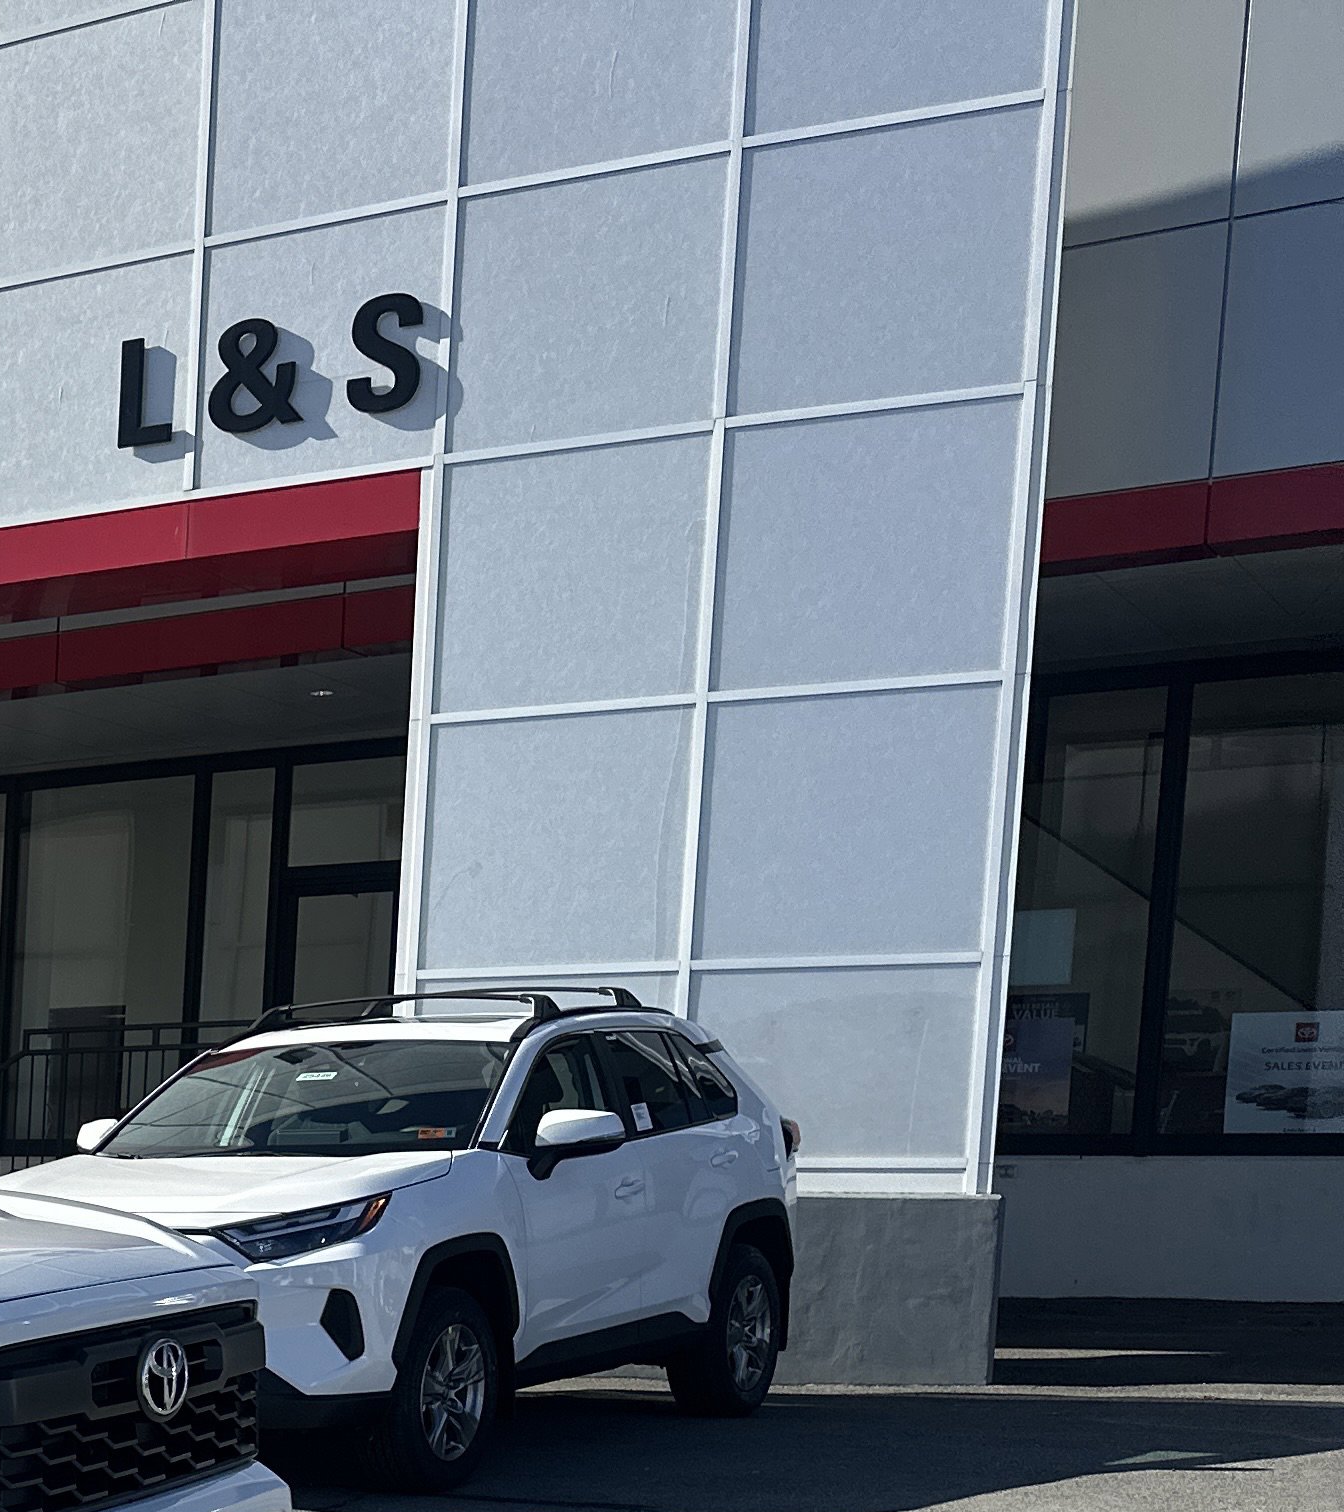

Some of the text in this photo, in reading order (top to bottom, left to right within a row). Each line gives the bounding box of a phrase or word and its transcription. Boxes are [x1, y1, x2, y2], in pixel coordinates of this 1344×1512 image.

[117, 293, 424, 449] L & S
[1264, 1061, 1303, 1071] SALES
